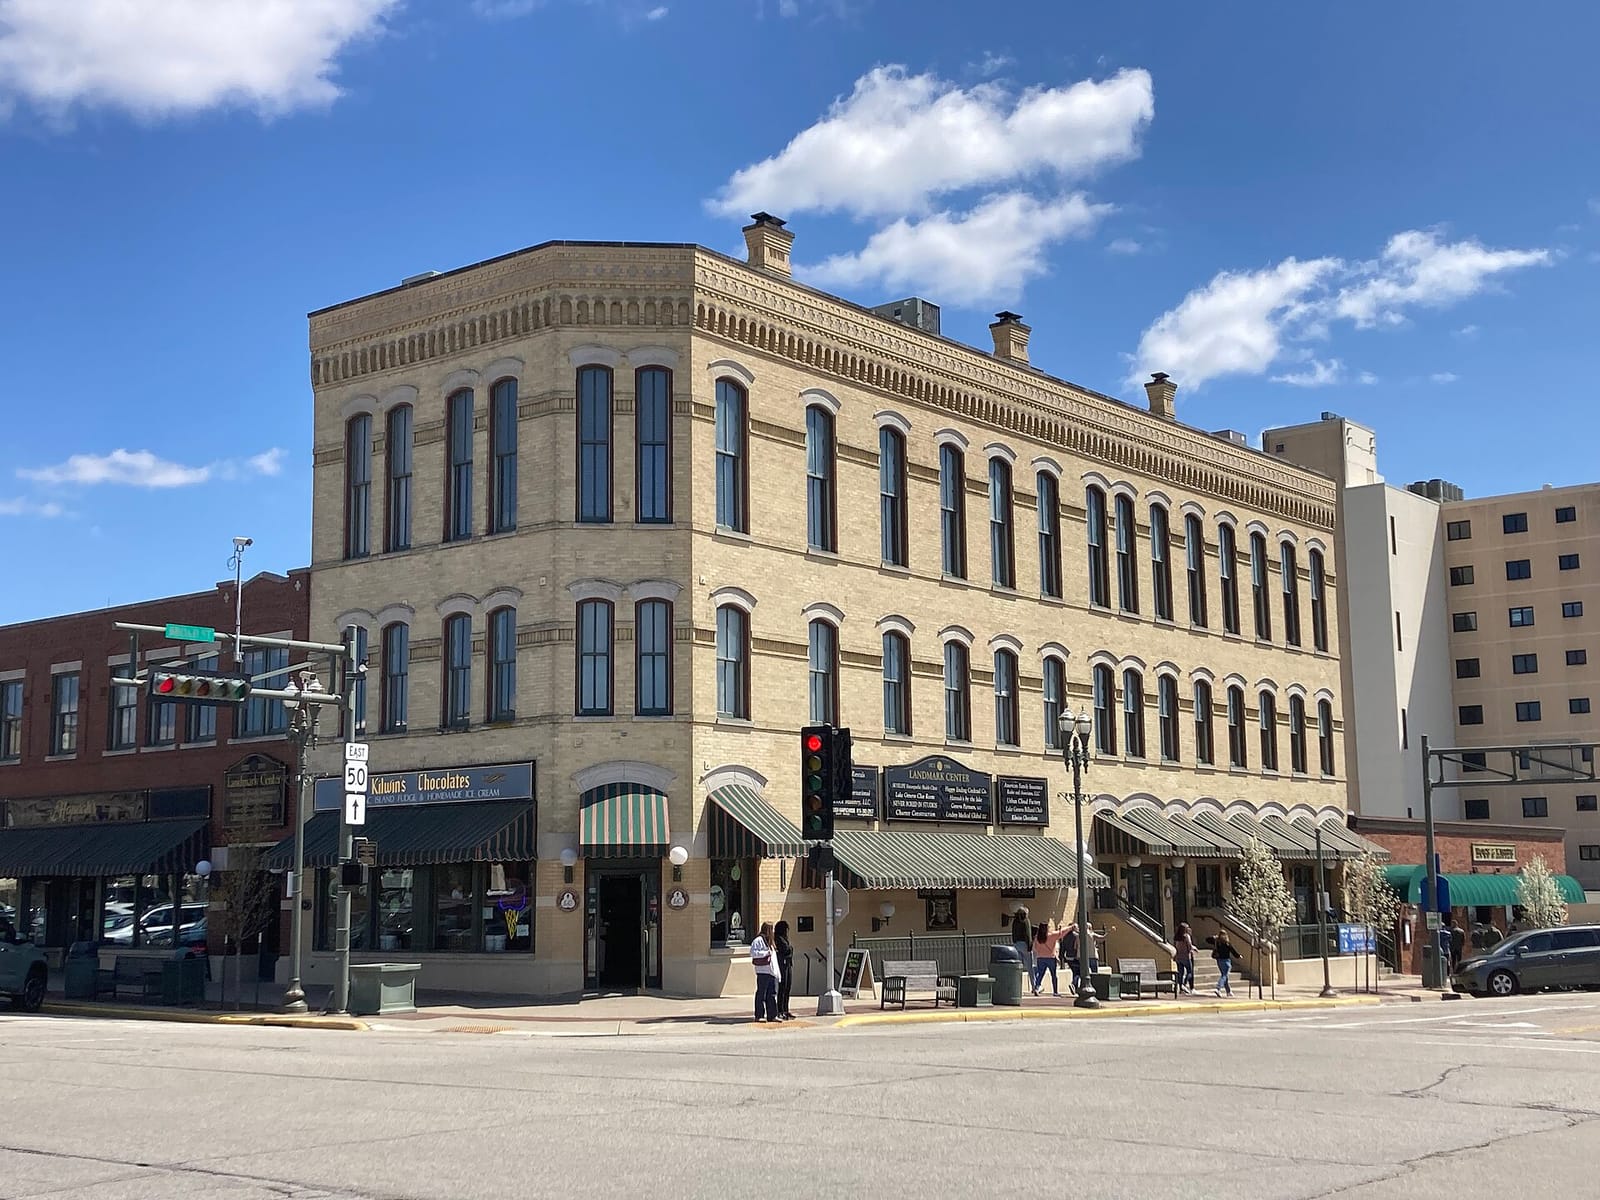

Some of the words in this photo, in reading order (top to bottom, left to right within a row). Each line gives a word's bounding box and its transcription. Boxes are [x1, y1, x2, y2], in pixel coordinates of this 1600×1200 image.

[349, 745, 365, 758] EAST
[347, 767, 365, 786] 50
[371, 776, 406, 795] Kilwin's
[418, 772, 471, 791] Chocolates
[909, 769, 945, 781] LANDMARK
[945, 772, 970, 783] CENTER
[375, 795, 395, 804] ISLAND
[397, 793, 416, 803] FUDGE
[427, 790, 463, 801] HOMEMADE
[465, 790, 474, 799] ICE
[478, 788, 500, 798] CREAM
